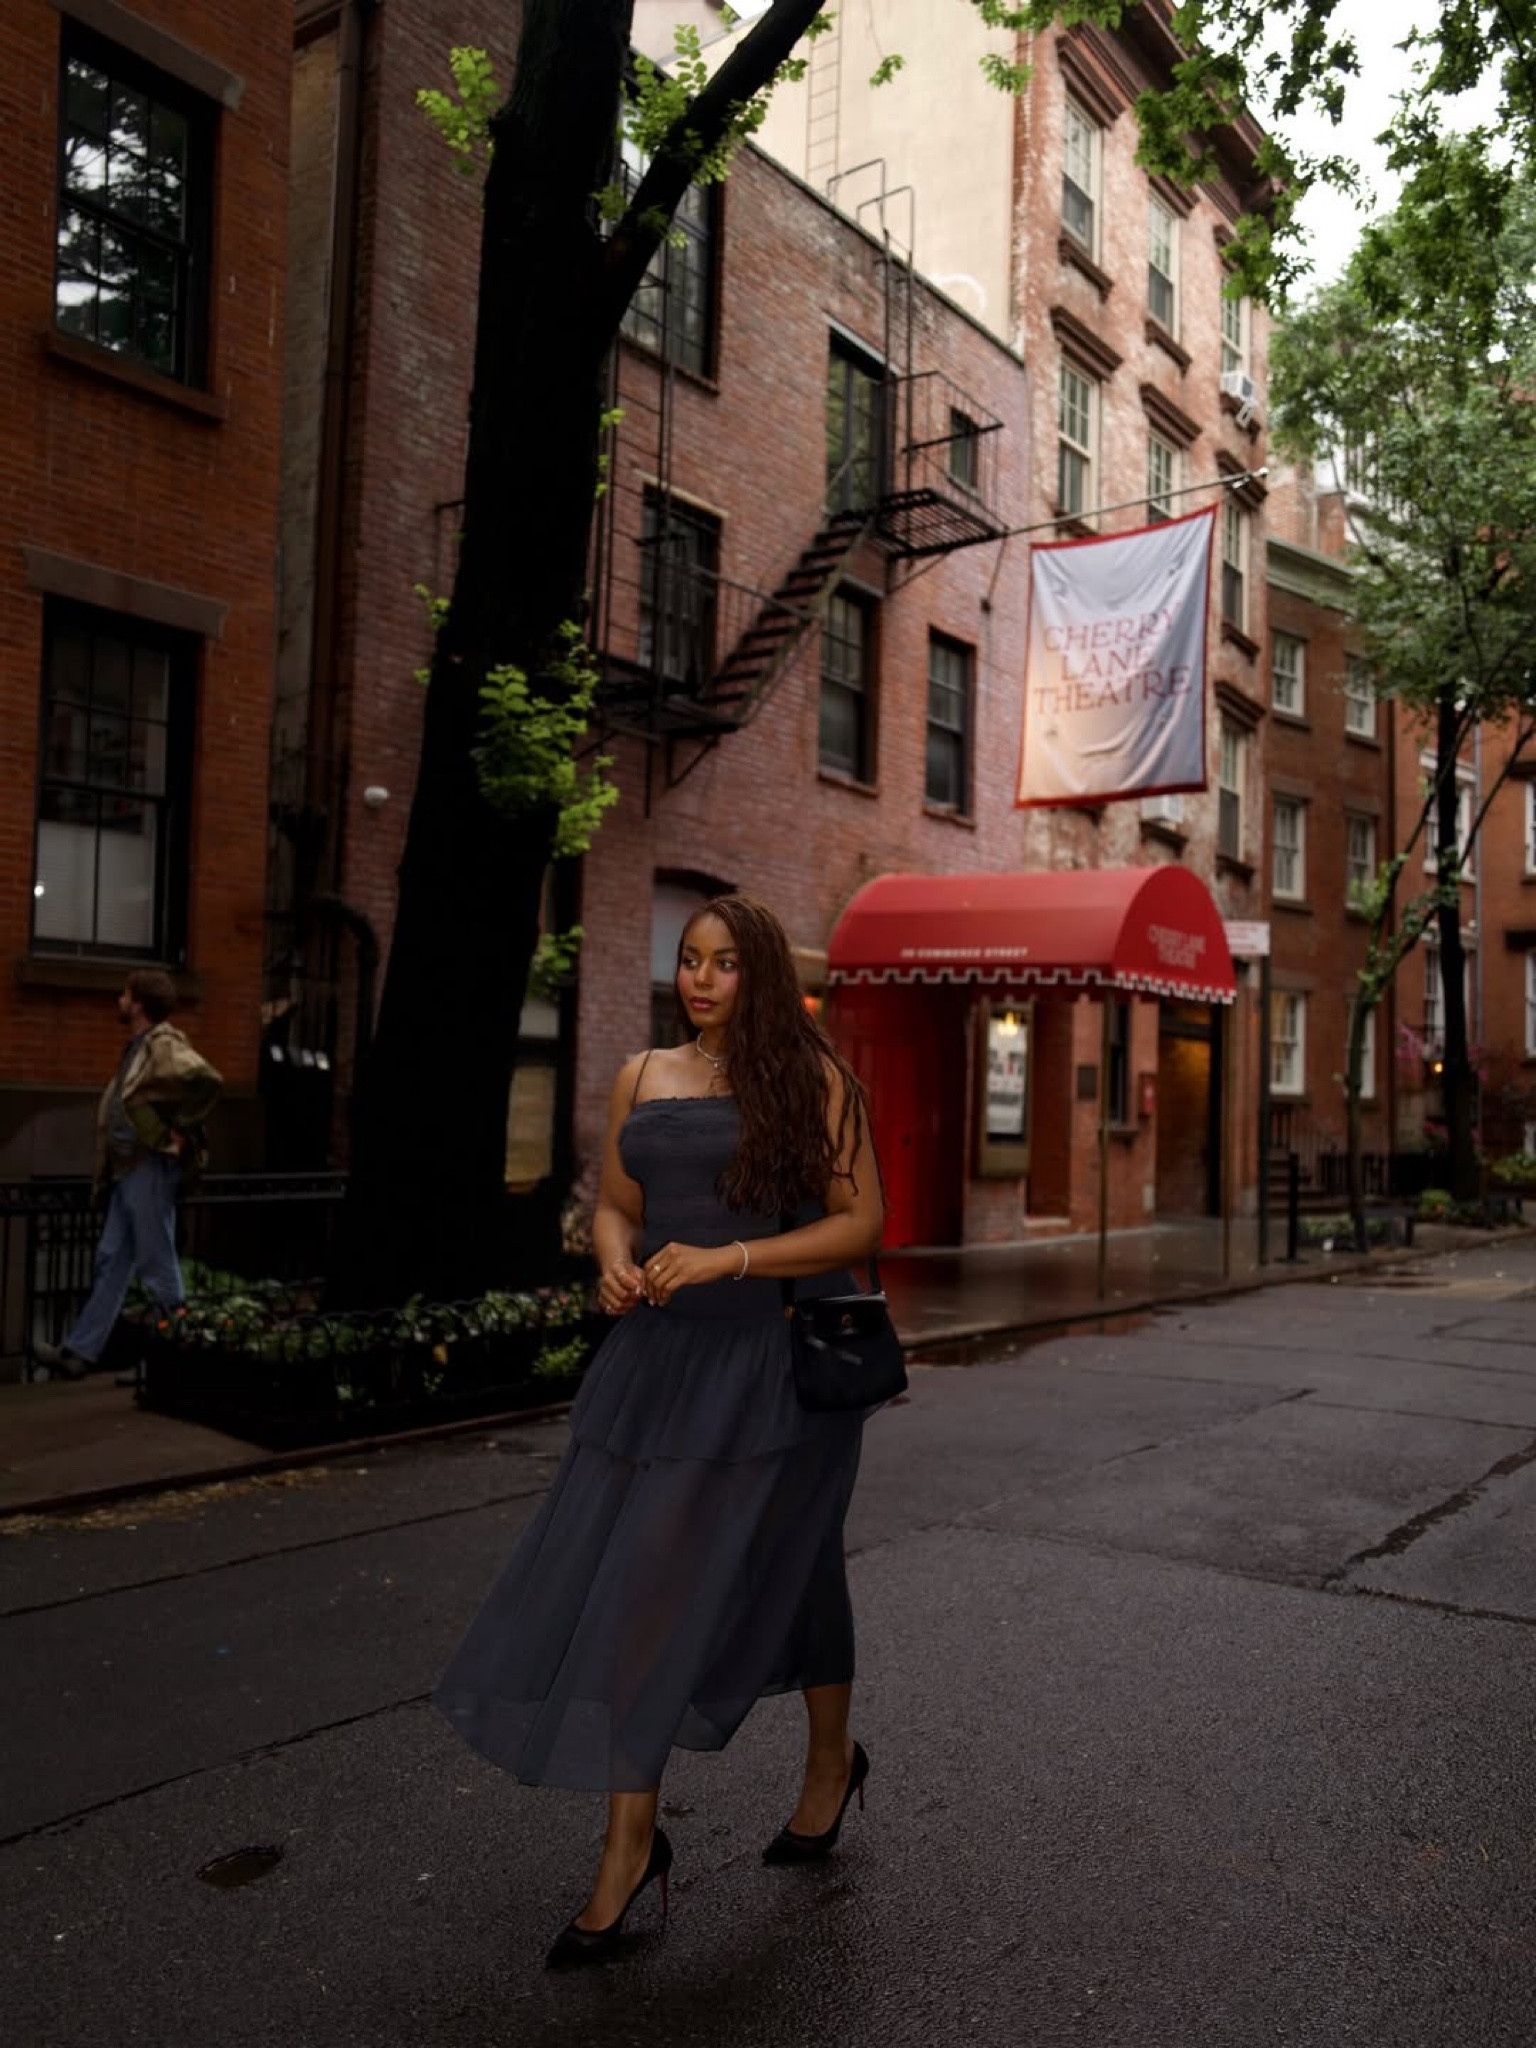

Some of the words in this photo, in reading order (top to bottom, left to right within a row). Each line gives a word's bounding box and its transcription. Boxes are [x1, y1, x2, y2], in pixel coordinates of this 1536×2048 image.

[1044, 603, 1182, 651] CHERRY
[1060, 646, 1154, 681] LANE
[1034, 665, 1192, 715] THEATRE
